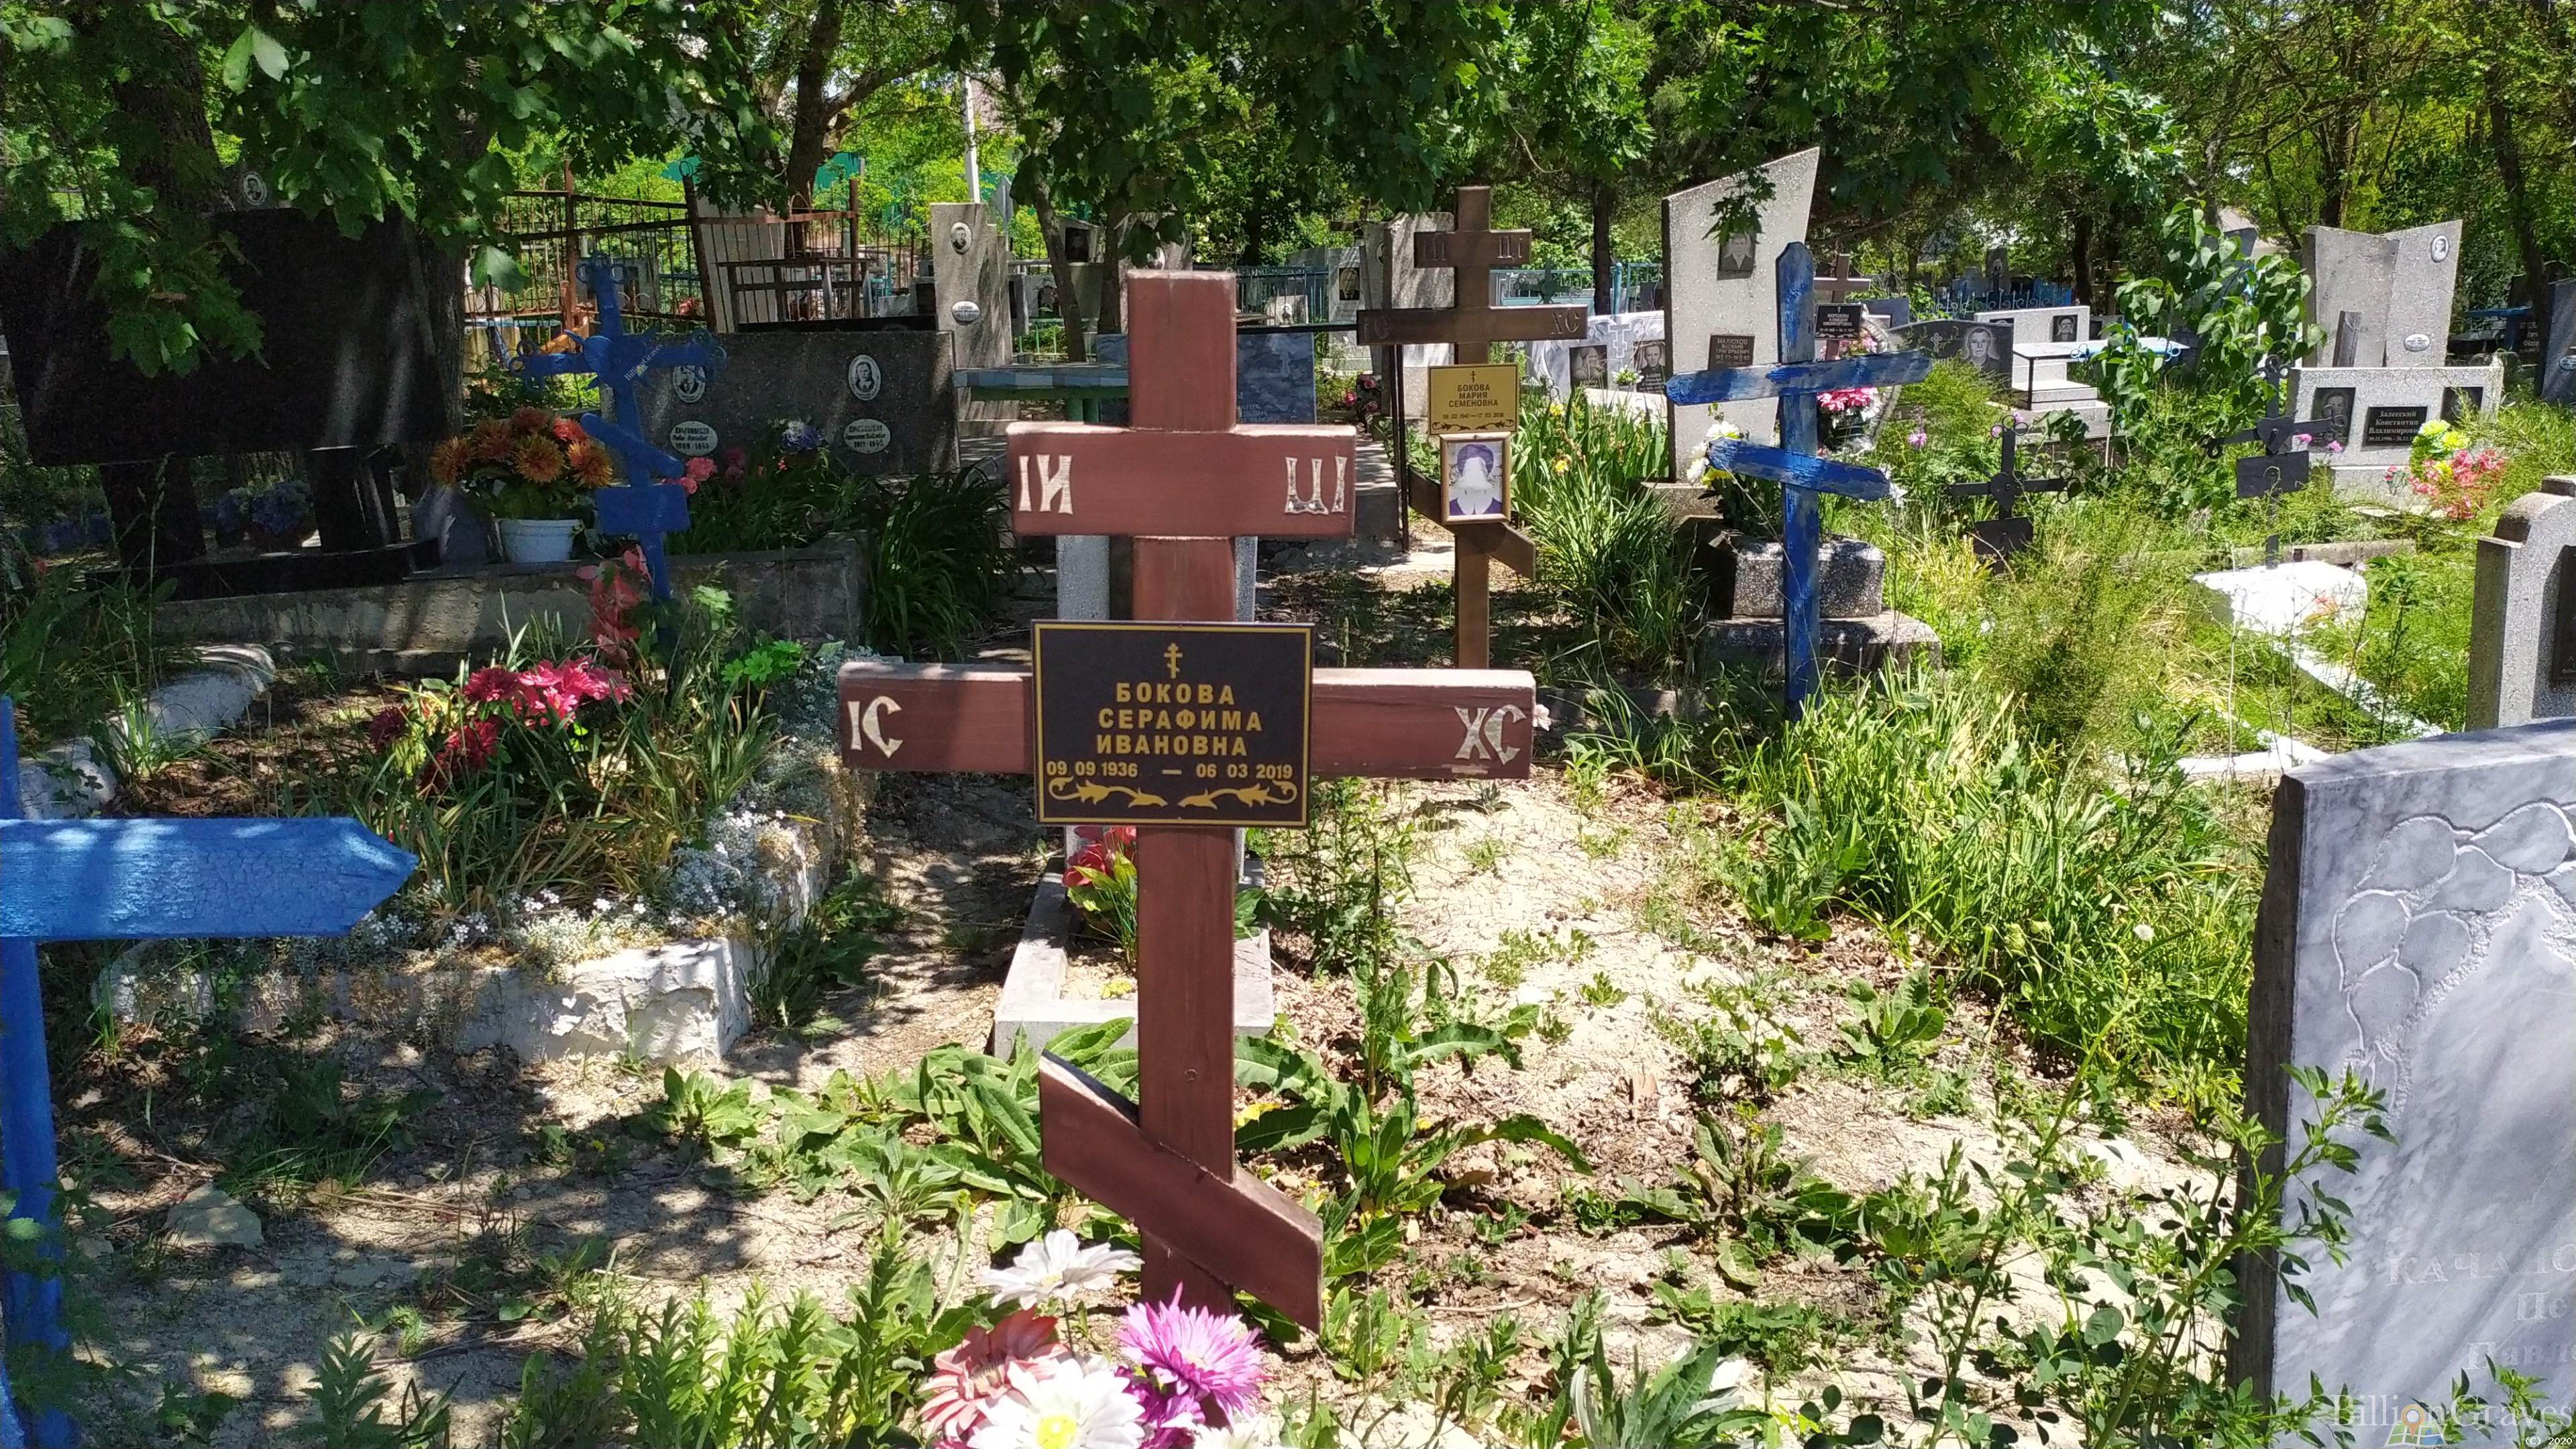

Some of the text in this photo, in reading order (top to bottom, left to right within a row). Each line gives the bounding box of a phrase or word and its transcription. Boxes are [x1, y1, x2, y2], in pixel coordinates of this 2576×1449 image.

[1457, 384, 1490, 392] БОКОВА
[1458, 391, 1488, 399] МАРИЯ
[1448, 399, 1499, 408] СЕМЕНОВНА
[1116, 682, 1235, 705] БОКОВА
[1098, 708, 1263, 732] СЕРАФИМА
[1096, 735, 1248, 756] ИВАНОВНА
